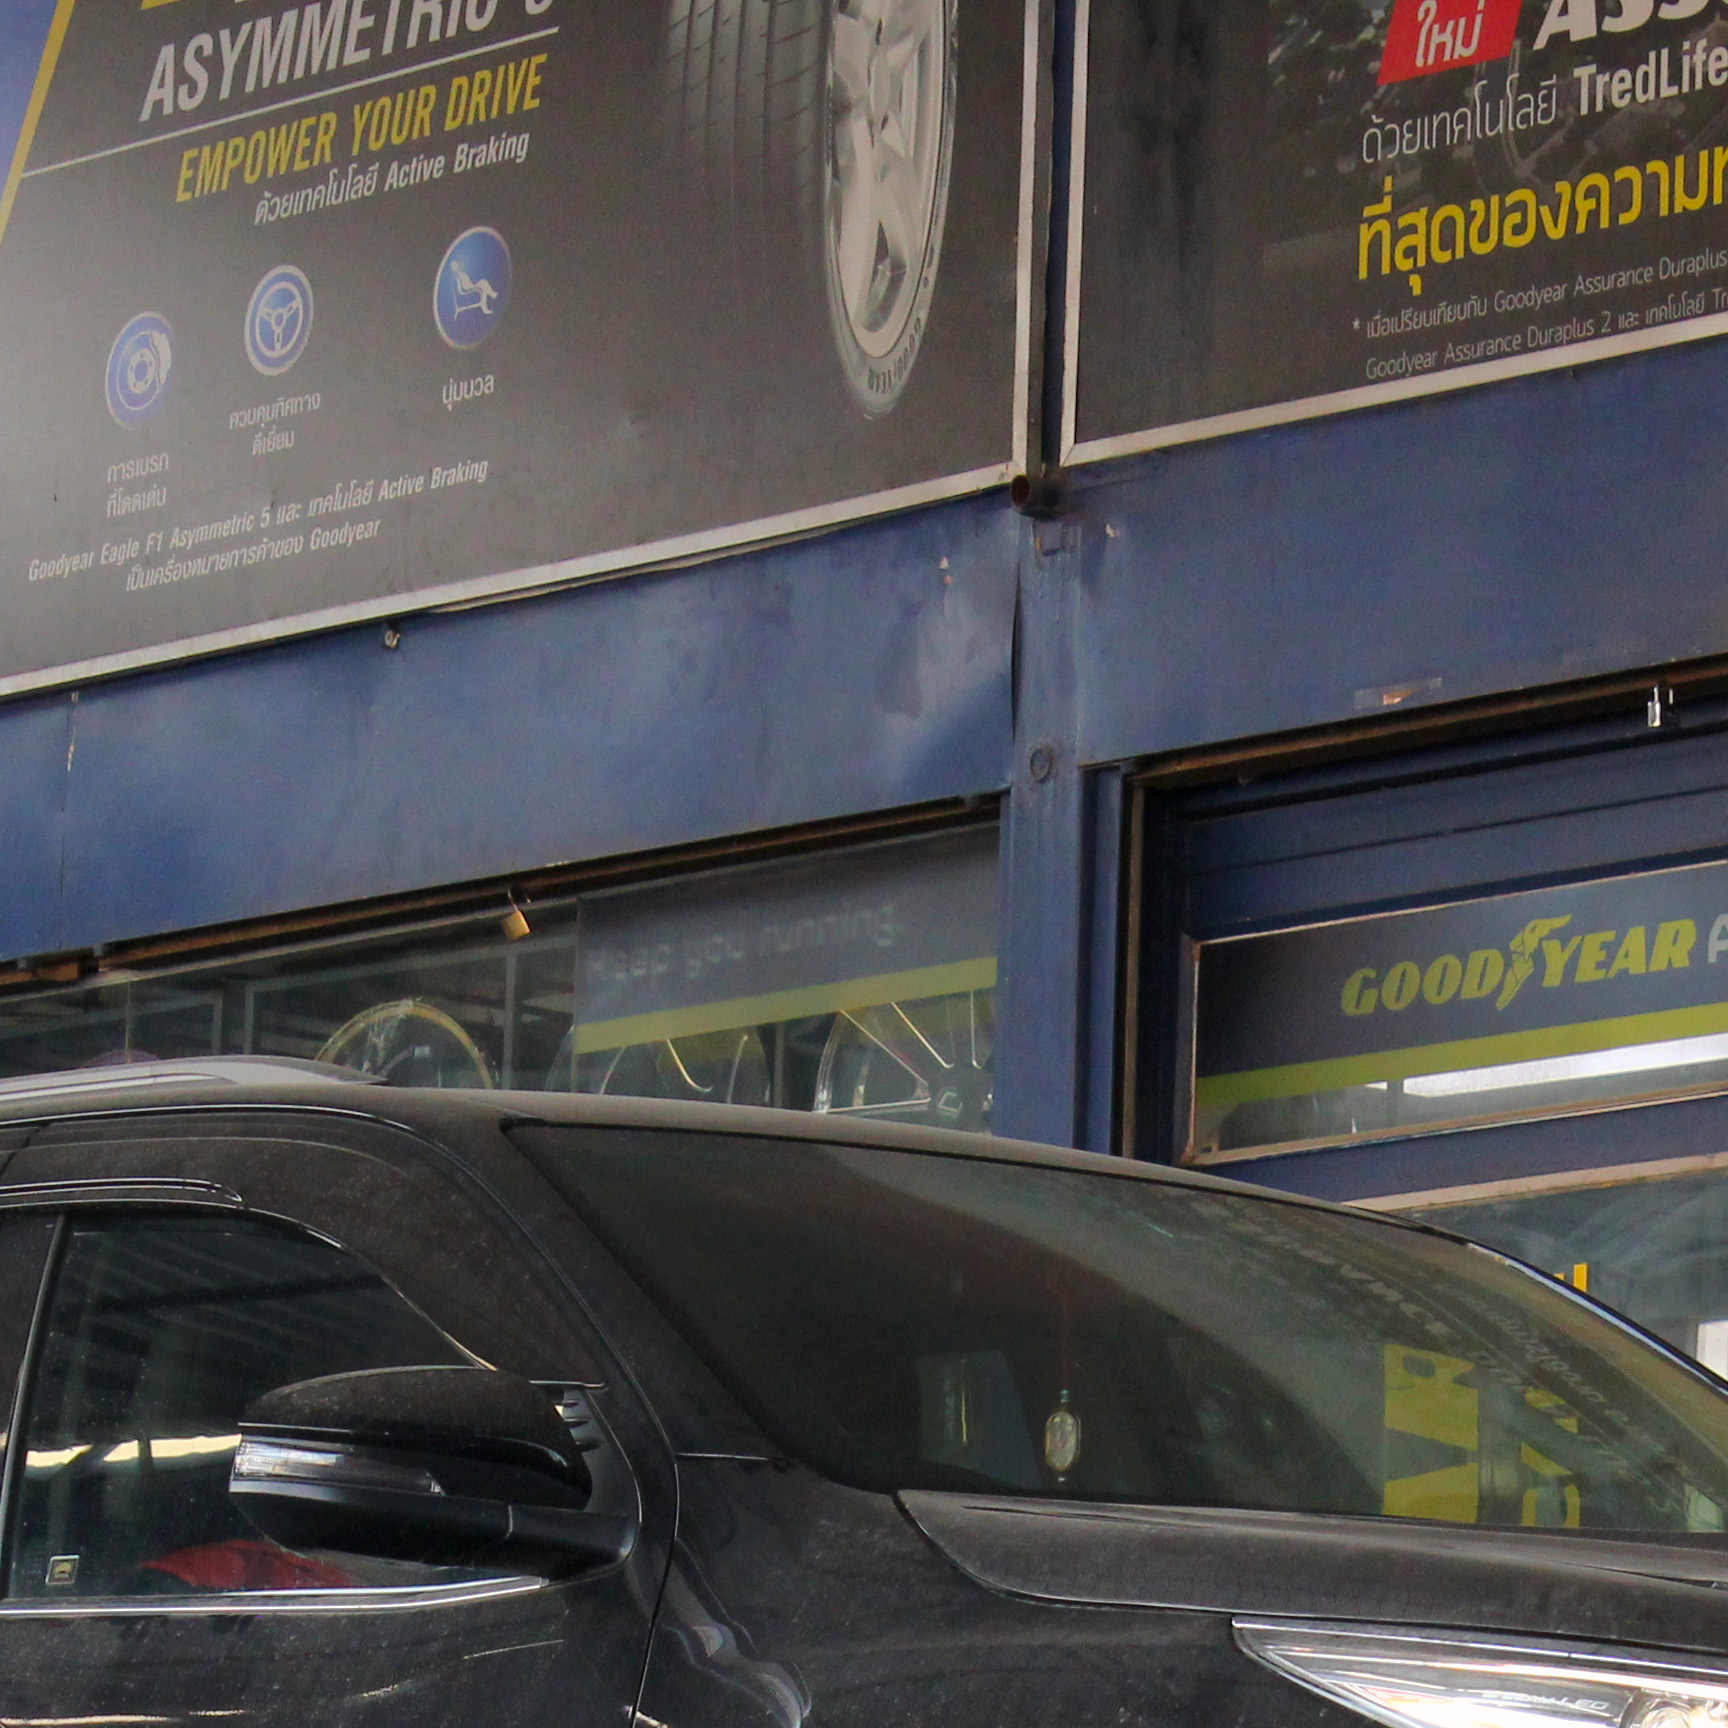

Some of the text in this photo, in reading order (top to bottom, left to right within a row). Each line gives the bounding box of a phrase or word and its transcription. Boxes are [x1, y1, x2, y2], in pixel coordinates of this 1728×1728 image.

[1414, 0, 1484, 67] ใหม่
[176, 53, 548, 202] EMPOWER YOUR DRIVE
[1362, 74, 1558, 164] ด้วยเทคโนโลยี
[254, 131, 530, 225] ด้วยเทคโนโลยี Active Braking
[1494, 281, 1567, 314] Goodyear
[1573, 264, 1653, 297] Assurance
[1659, 249, 1728, 280] Duraplus
[1366, 347, 1438, 380] Goodyear
[1444, 333, 1521, 364] Assurance
[1527, 316, 1594, 349] Duraplus
[1601, 311, 1610, 333] 2
[107, 452, 169, 484] การเบรก
[28, 457, 489, 582] Goodyear Eagle F1 Asymmetric 5 และ เทคโนโลยี Active Braking
[309, 516, 382, 555] Goodyear
[1341, 914, 1695, 1016] GOODYEAR
